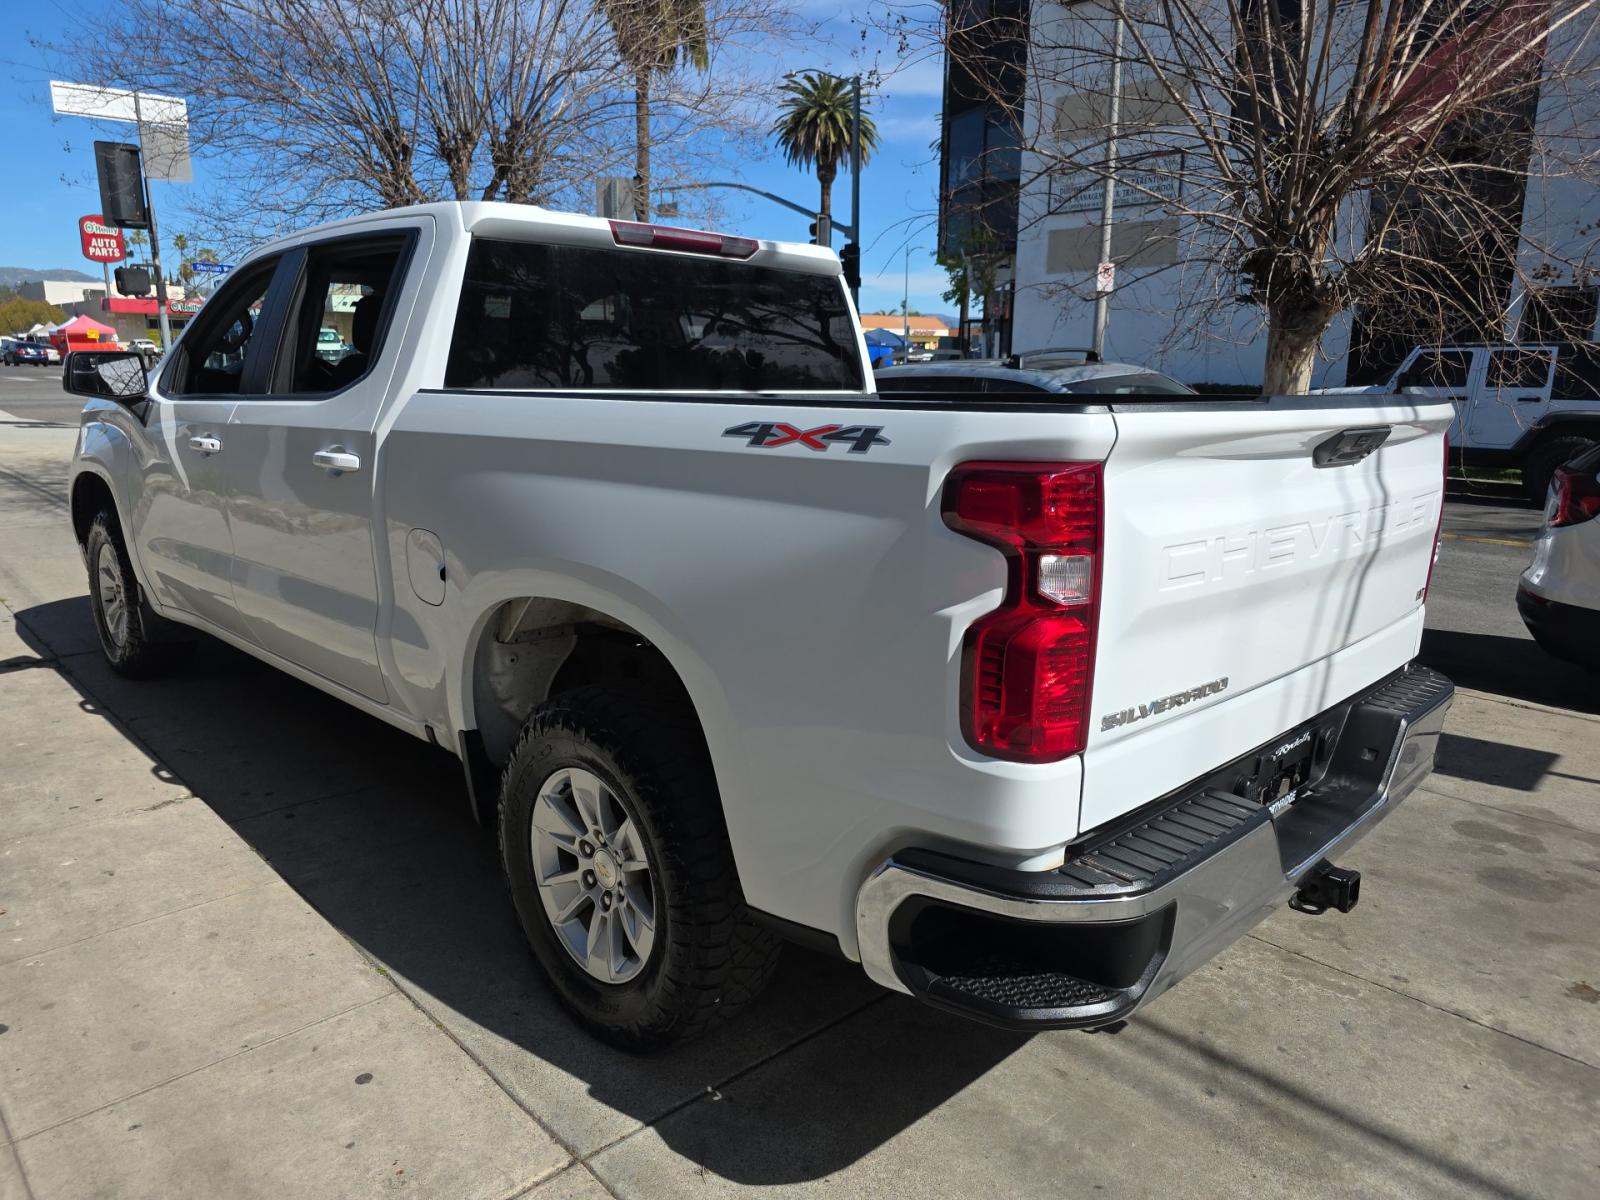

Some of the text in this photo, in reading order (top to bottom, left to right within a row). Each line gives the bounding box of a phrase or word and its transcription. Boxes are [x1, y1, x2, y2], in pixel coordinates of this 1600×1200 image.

[89, 247, 120, 257] PARTS
[91, 238, 117, 248] AUTO
[1157, 490, 1442, 592] CHEVROLET
[1100, 676, 1229, 733] SILVERADO
